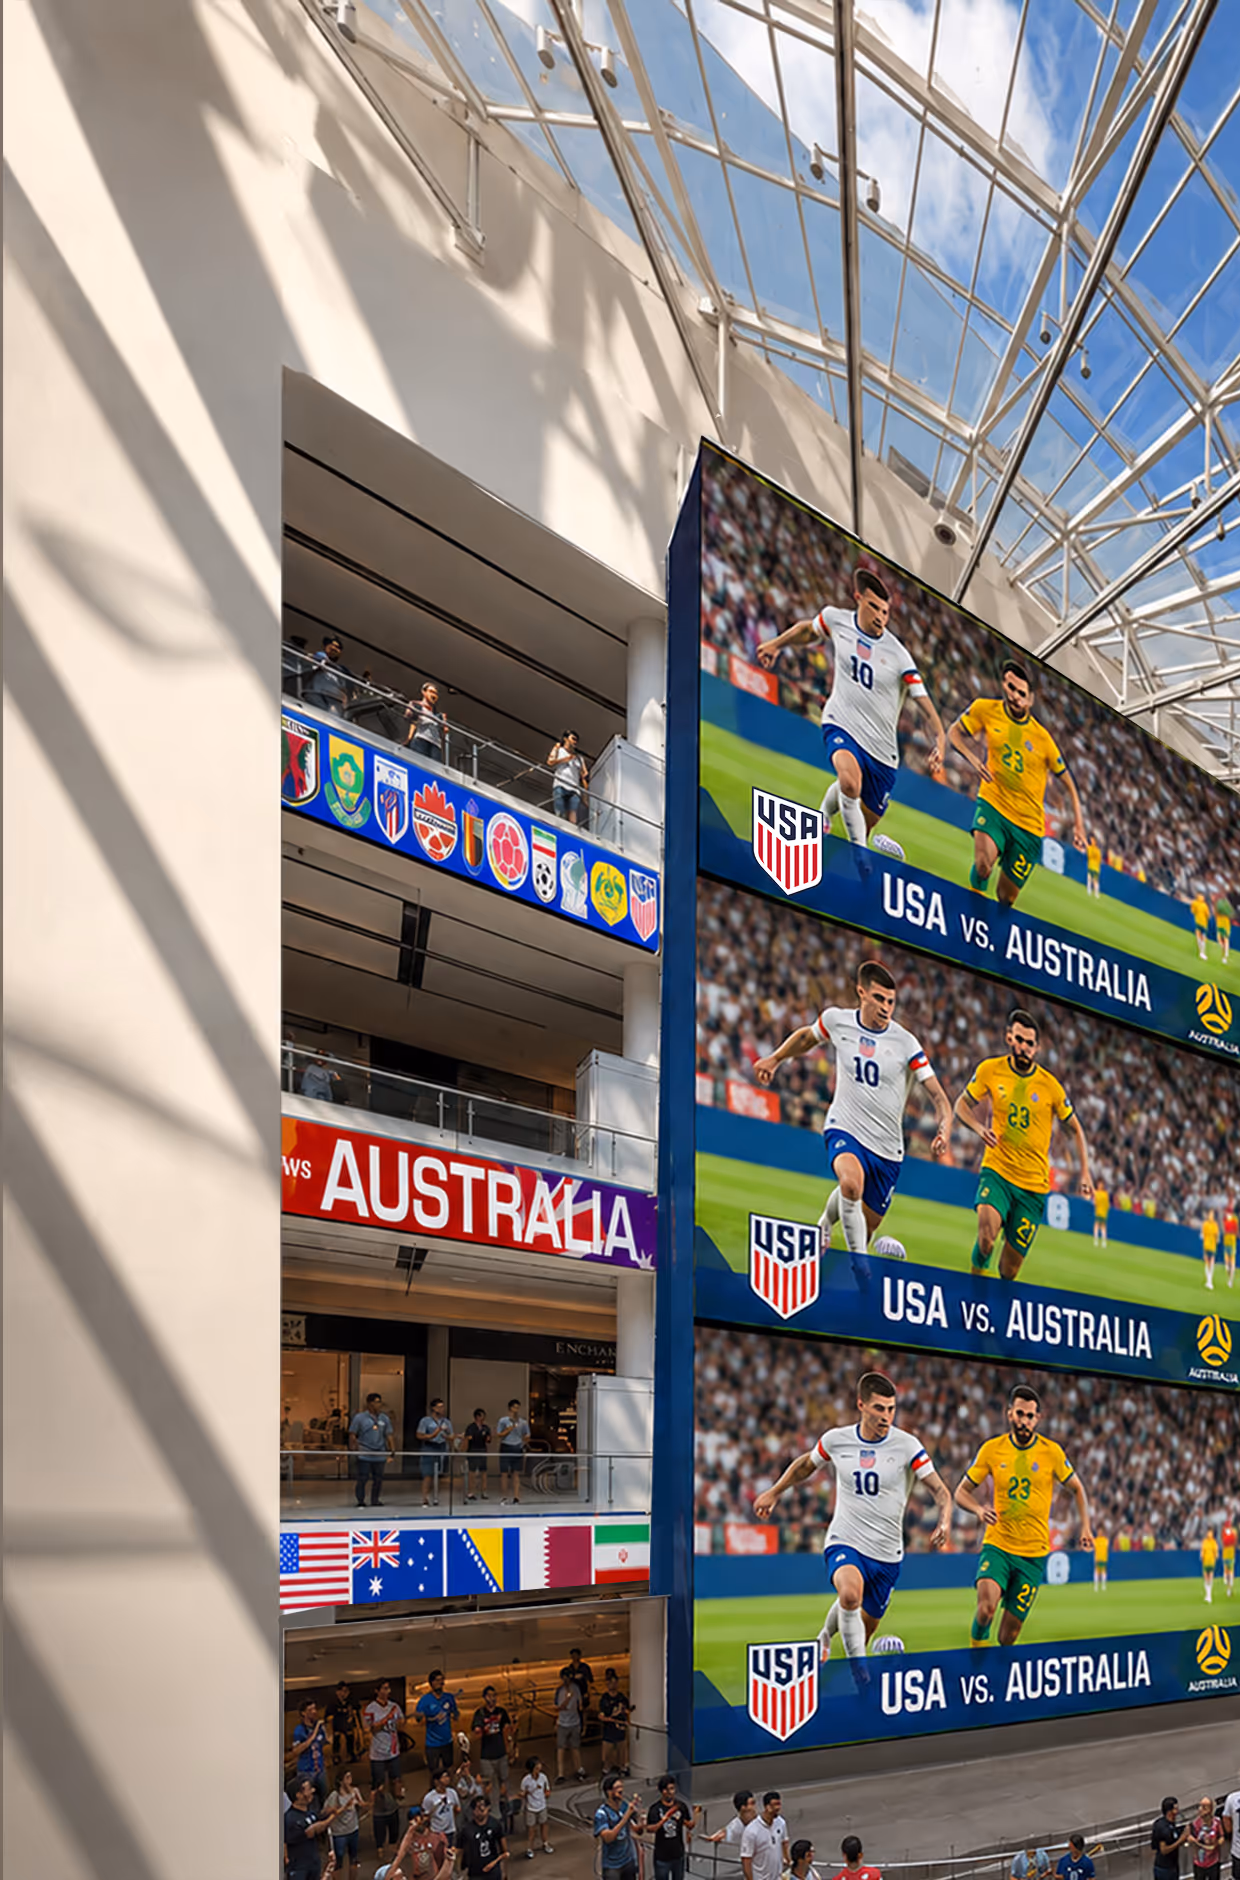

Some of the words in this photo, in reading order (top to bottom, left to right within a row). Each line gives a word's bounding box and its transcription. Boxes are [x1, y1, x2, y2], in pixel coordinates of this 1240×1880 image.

[850, 655, 874, 691] 10
[1002, 743, 1024, 773] 23
[758, 790, 820, 840] USA
[882, 872, 947, 937] USA
[1005, 924, 1152, 1012] AUSTRALIA
[853, 1055, 880, 1088] 10
[1007, 1101, 1031, 1131] 23
[320, 1138, 638, 1262] AUSTRALIA
[754, 1216, 819, 1263] USA
[883, 1276, 949, 1329] USA
[1006, 1298, 1153, 1359] AUSTRALIA
[852, 1470, 880, 1497] 10
[1007, 1475, 1031, 1501] 23
[752, 1644, 815, 1686] USA
[881, 1667, 947, 1716] USA
[1005, 1650, 1152, 1702] AUSTRALIA
